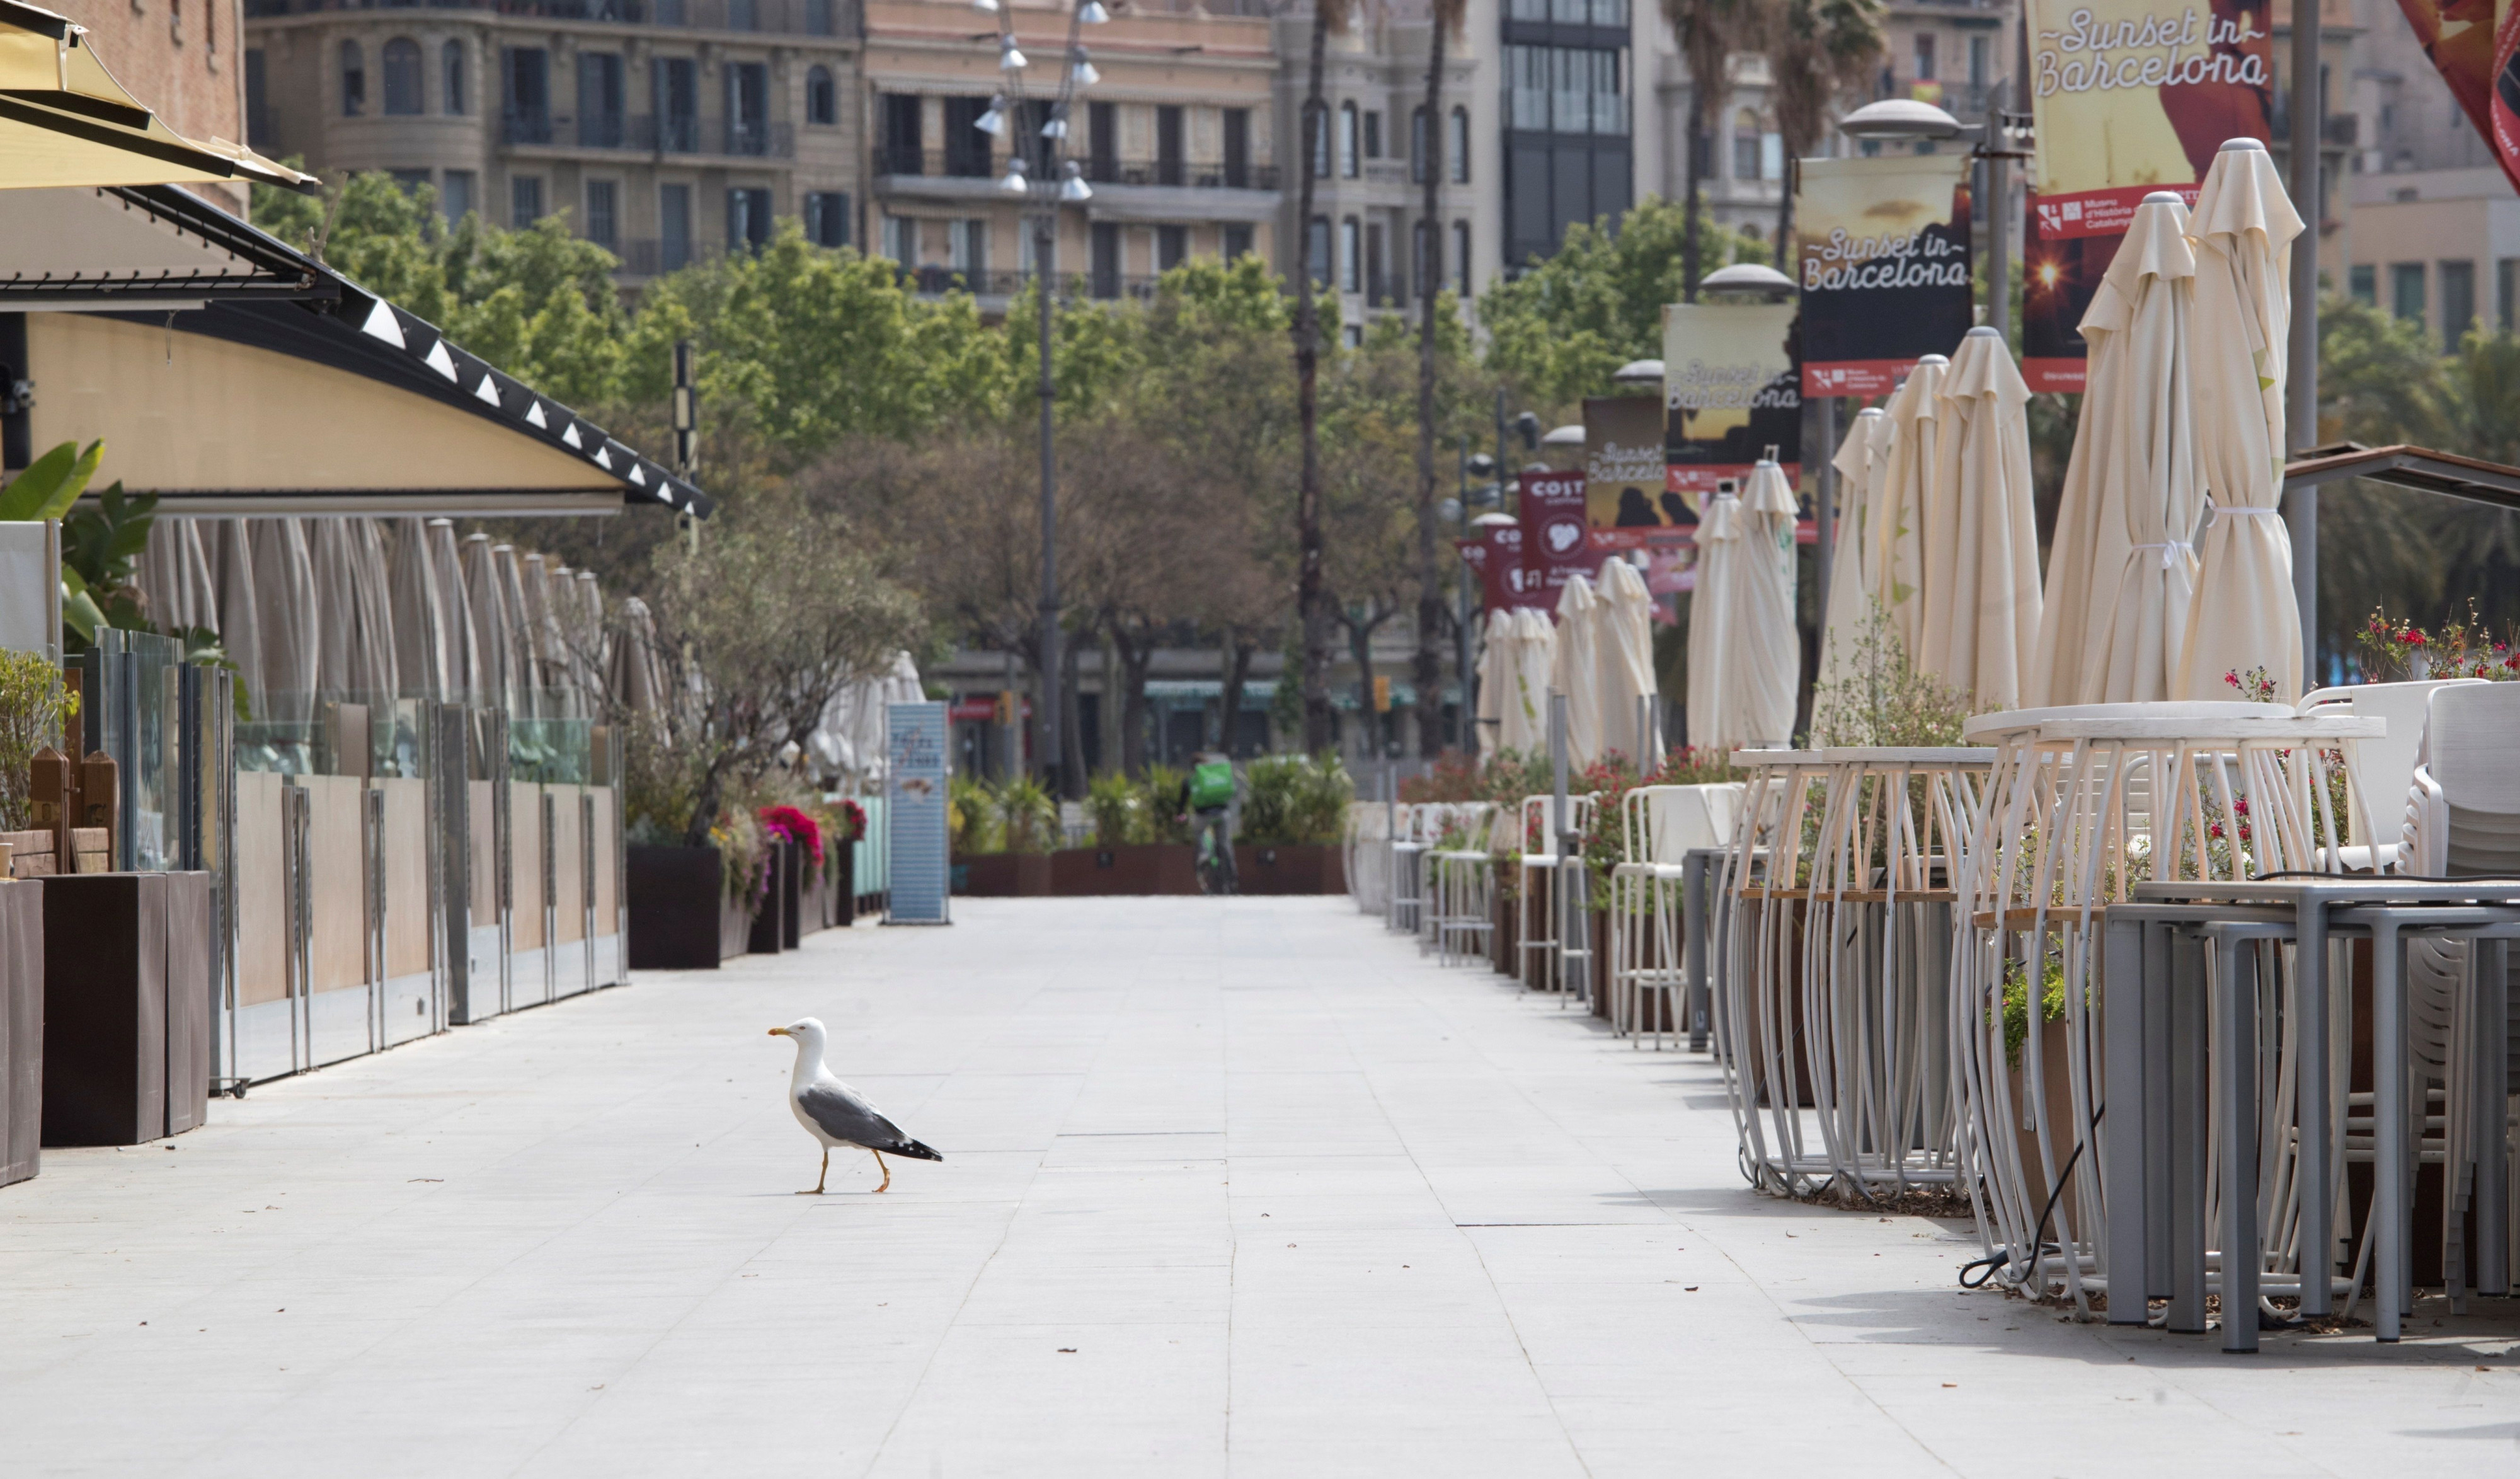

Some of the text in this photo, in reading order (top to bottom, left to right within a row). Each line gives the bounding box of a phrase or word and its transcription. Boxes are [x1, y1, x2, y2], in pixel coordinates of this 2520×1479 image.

[2060, 9, 2243, 52] Sunset in
[2036, 46, 2268, 97] Barcelona
[1821, 227, 1951, 262] Sunset in
[1803, 256, 1967, 291] Barcelona
[1669, 381, 1801, 410] Barcelona
